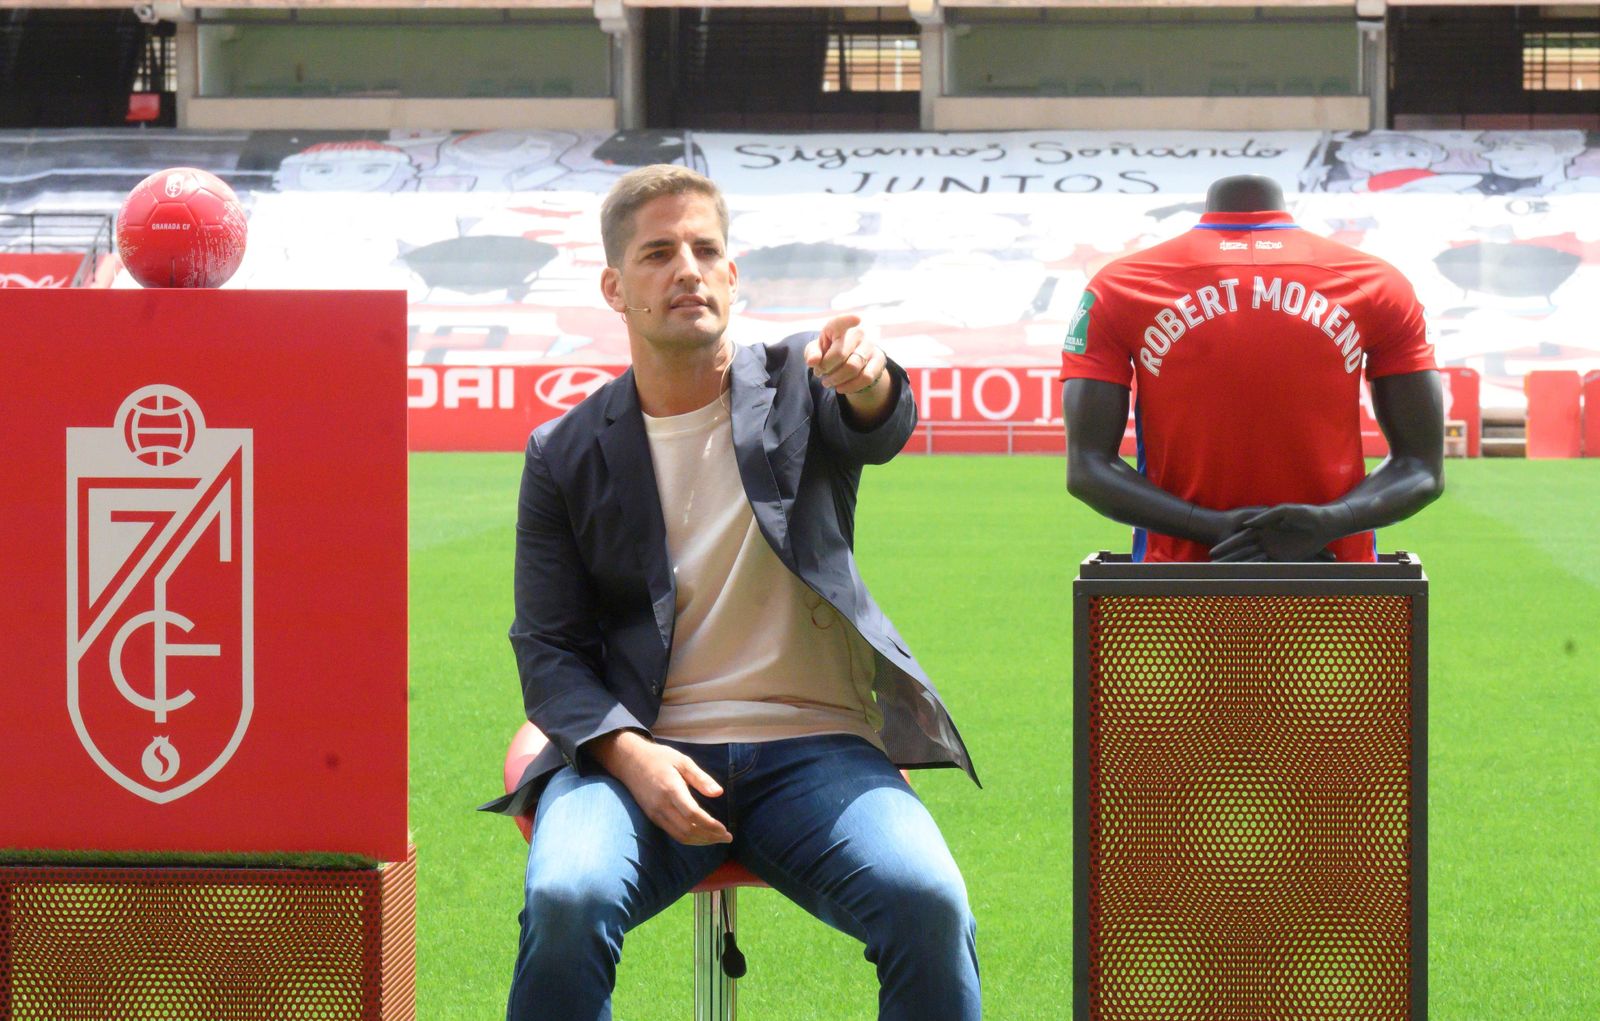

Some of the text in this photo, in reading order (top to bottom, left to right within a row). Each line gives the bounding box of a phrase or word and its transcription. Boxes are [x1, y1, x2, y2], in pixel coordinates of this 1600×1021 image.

[735, 143, 1007, 170] Sigamos
[824, 170, 1160, 195] JUNTOS
[151, 223, 181, 231] GRANADA
[1139, 274, 1362, 378] ROBERT MORENO
